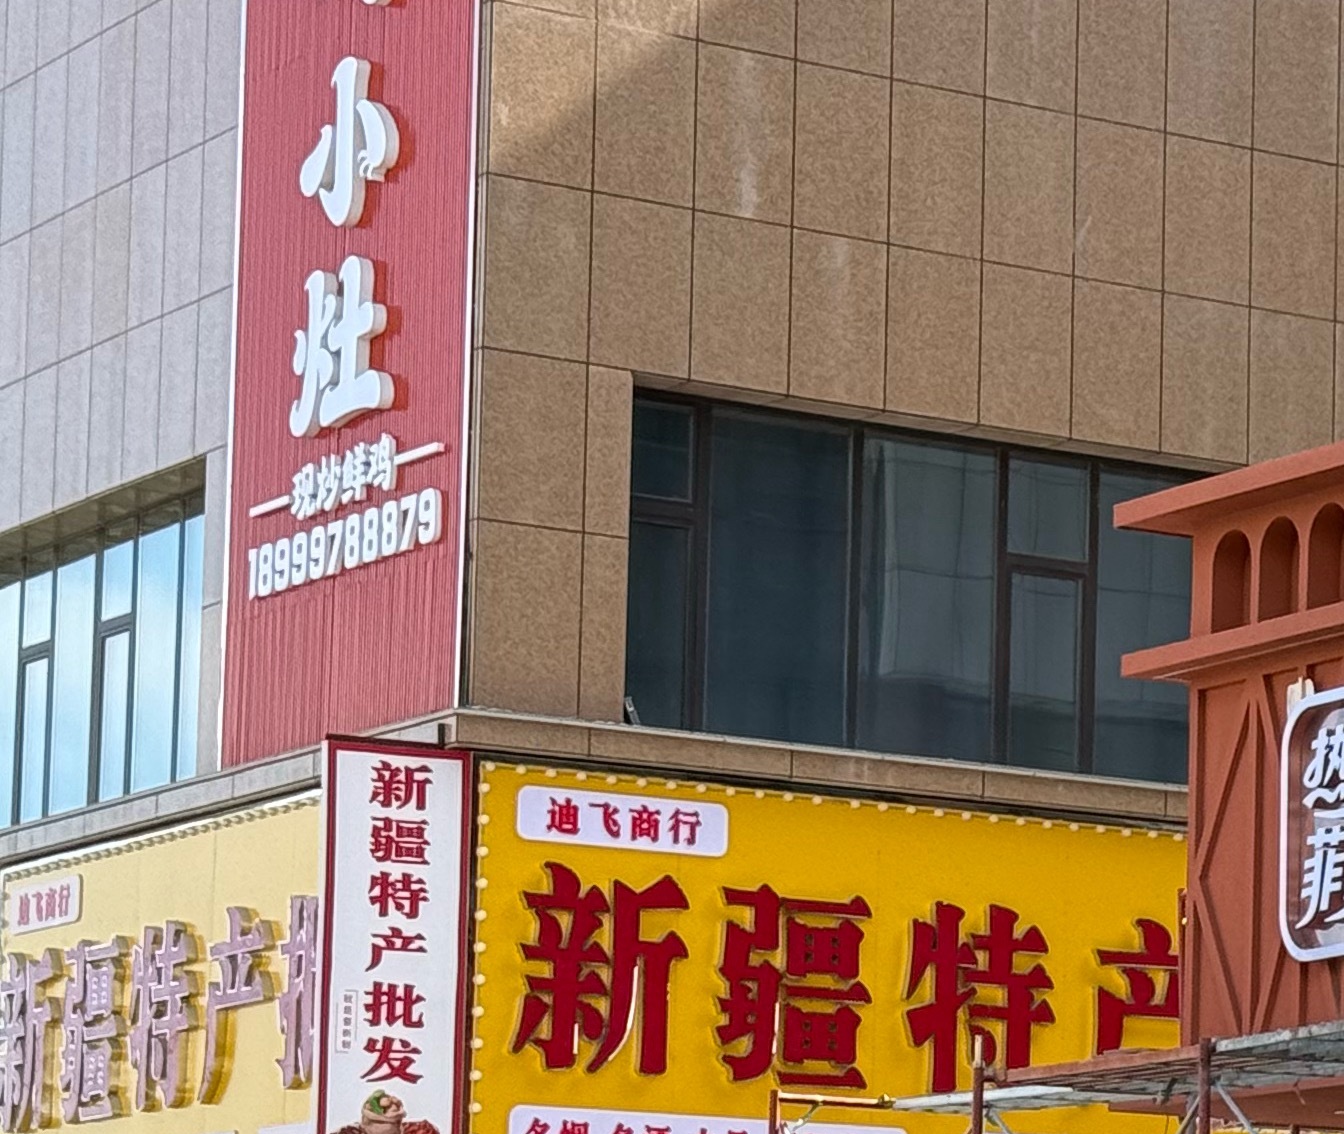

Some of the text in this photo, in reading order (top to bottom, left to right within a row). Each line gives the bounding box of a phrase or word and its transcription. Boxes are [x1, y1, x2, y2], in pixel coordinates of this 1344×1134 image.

[289, 0, 400, 438] 小灶
[248, 487, 442, 601] 18999788879
[290, 432, 397, 521] 现炒鲜鸡
[546, 797, 702, 846] 迪飞商行
[361, 759, 434, 1086] 新疆特产批发
[509, 861, 1179, 1094] 新疆特产
